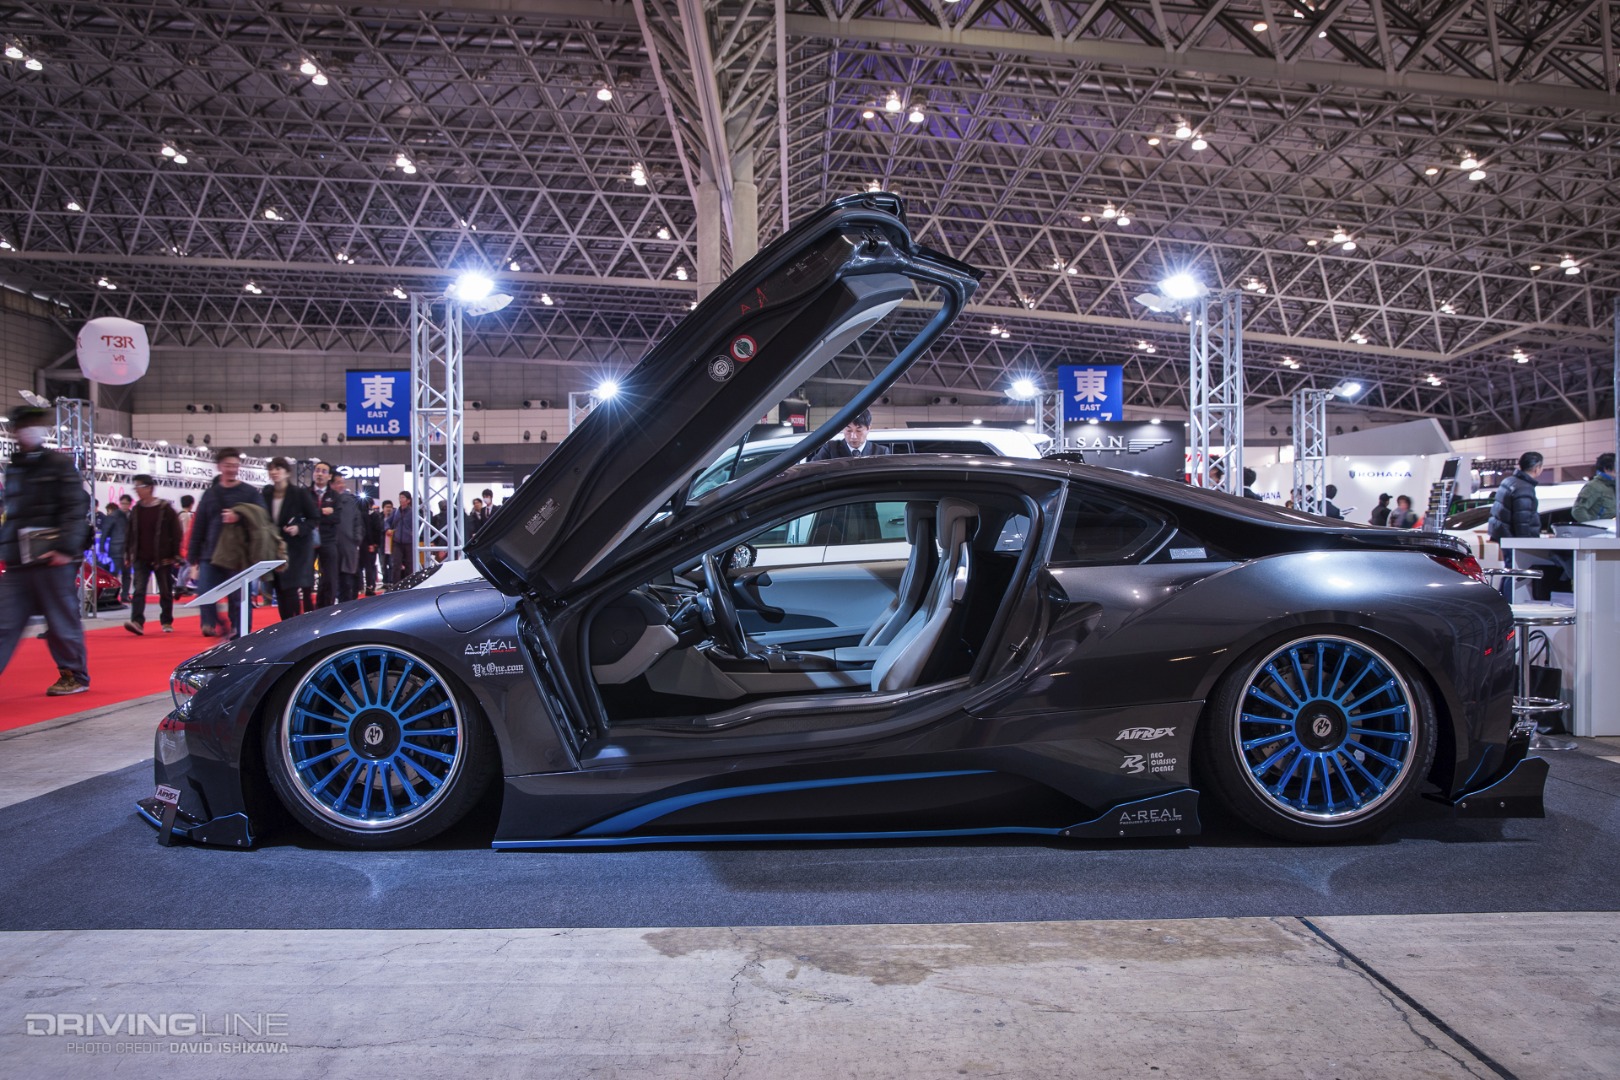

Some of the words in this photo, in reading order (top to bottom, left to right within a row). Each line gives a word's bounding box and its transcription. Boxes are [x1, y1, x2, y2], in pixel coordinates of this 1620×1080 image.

[100, 335, 136, 349] T3R
[361, 375, 395, 409] 東
[1073, 368, 1108, 402] 東
[1064, 435, 1124, 448] ISAN
[1120, 808, 1182, 821] A-REAL
